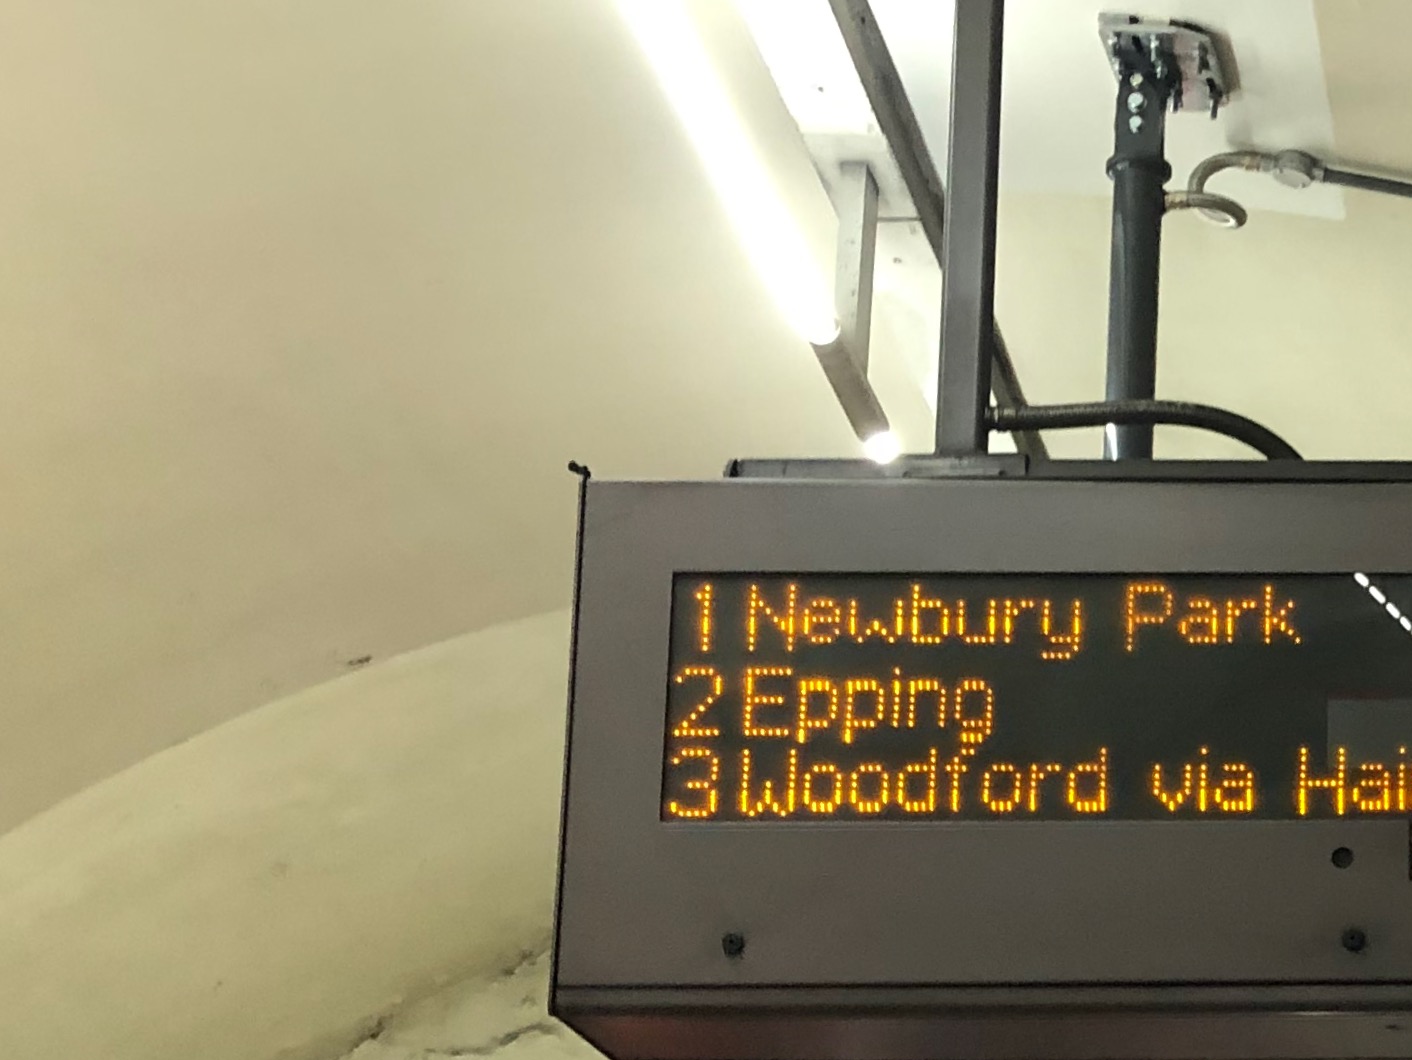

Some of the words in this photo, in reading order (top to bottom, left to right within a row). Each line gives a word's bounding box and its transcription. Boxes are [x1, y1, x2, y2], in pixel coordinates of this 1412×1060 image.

[693, 583, 713, 652] 1
[744, 583, 1084, 660] Newbury
[1124, 582, 1303, 654] Park
[672, 666, 725, 738] 2
[742, 666, 994, 743] Epping
[667, 746, 720, 818] 3
[737, 747, 1109, 818] Woodford
[1151, 747, 1257, 813] via
